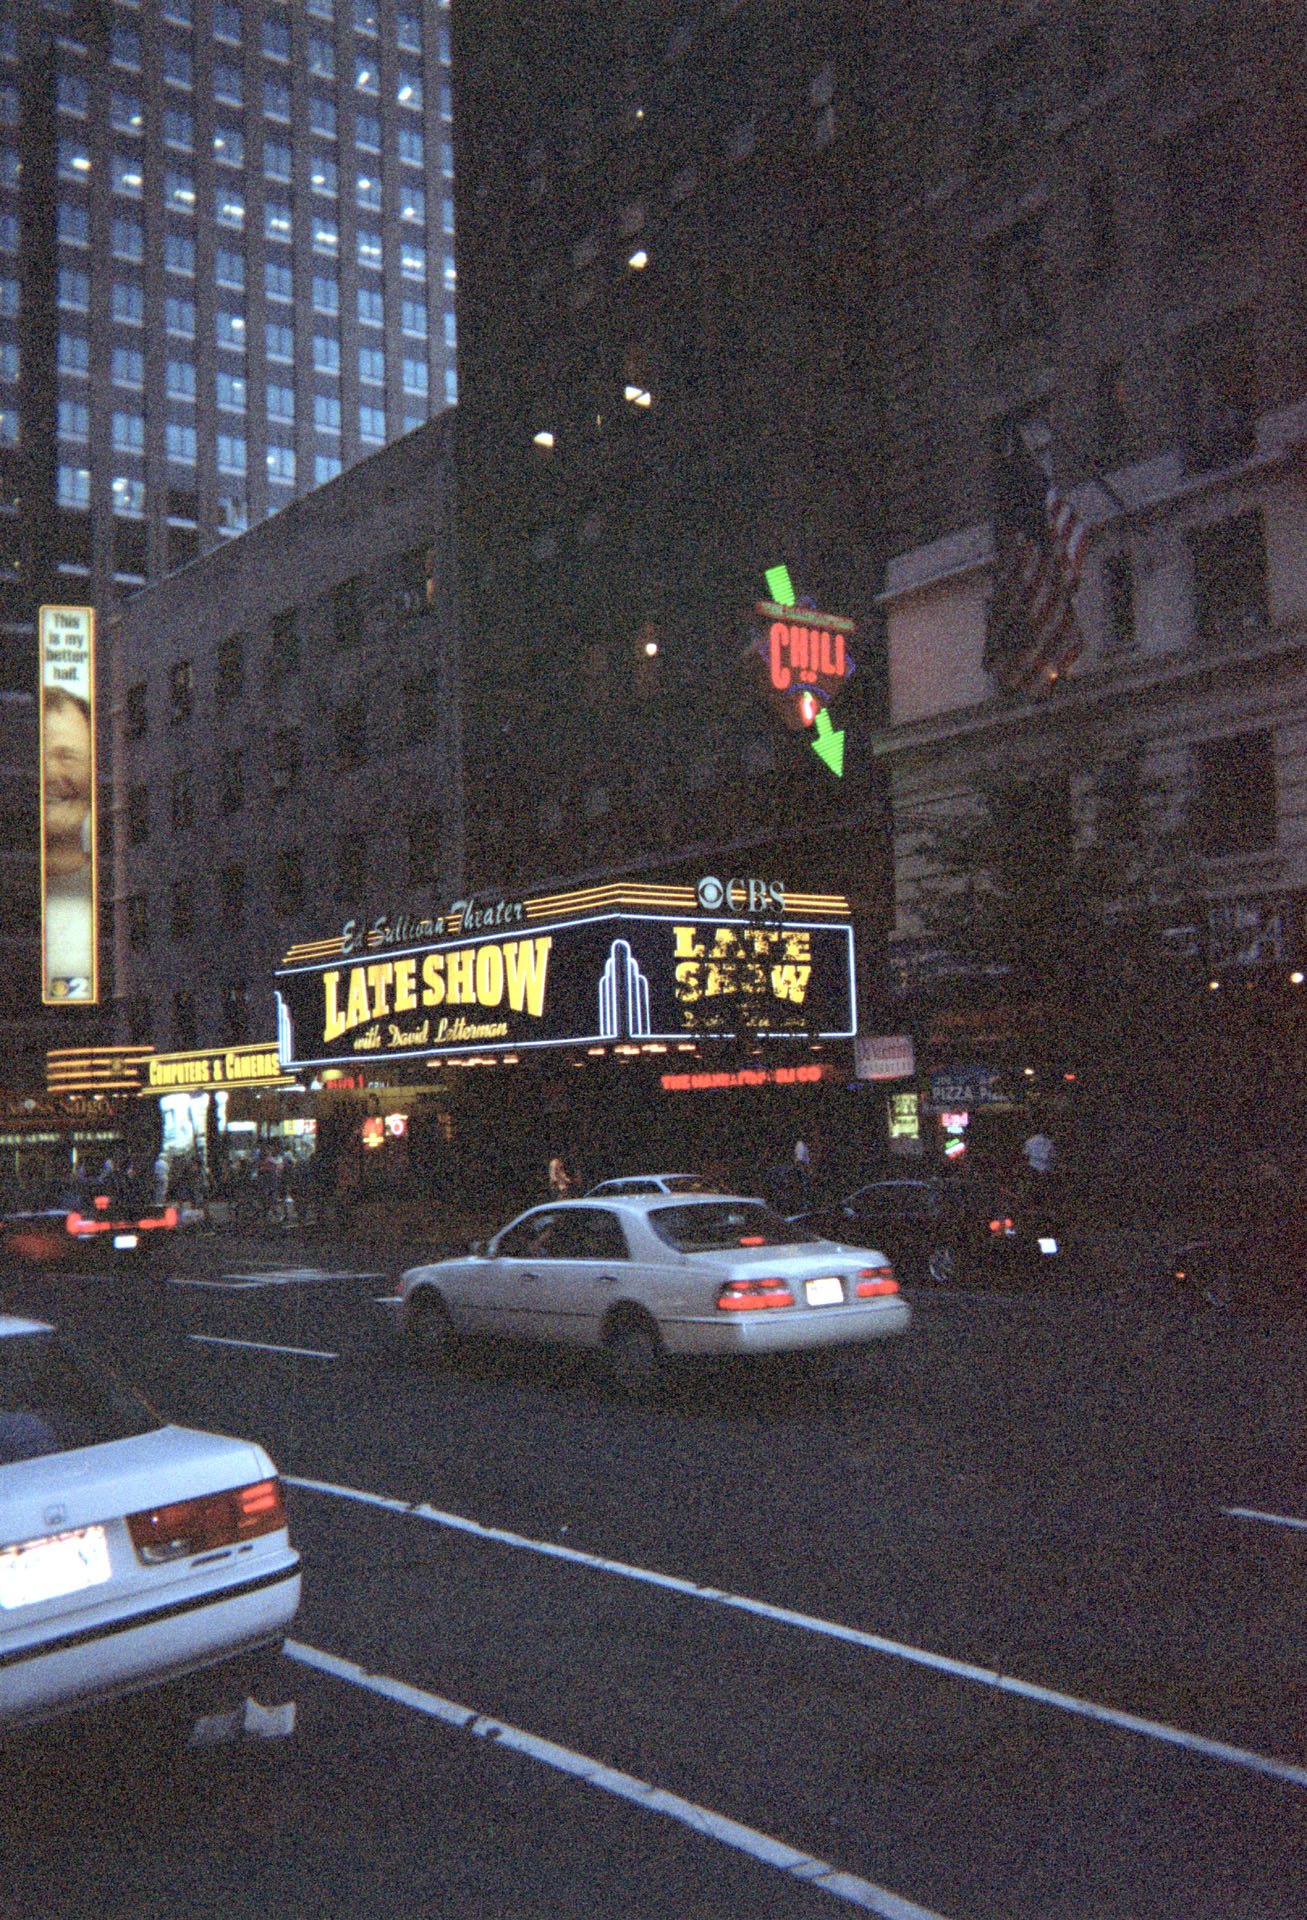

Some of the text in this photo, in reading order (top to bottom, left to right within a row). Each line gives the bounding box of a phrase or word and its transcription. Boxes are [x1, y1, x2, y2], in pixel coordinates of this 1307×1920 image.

[53, 613, 80, 629] This
[46, 647, 88, 664] better
[48, 631, 84, 648] is my
[726, 877, 786, 913] CBS
[341, 899, 524, 953] Ed Sullivan Theater
[322, 935, 553, 1043] LATE SHOW
[353, 1017, 509, 1050] with David Letterman
[149, 1052, 281, 1086] COMPUTERS & CAMERAS
